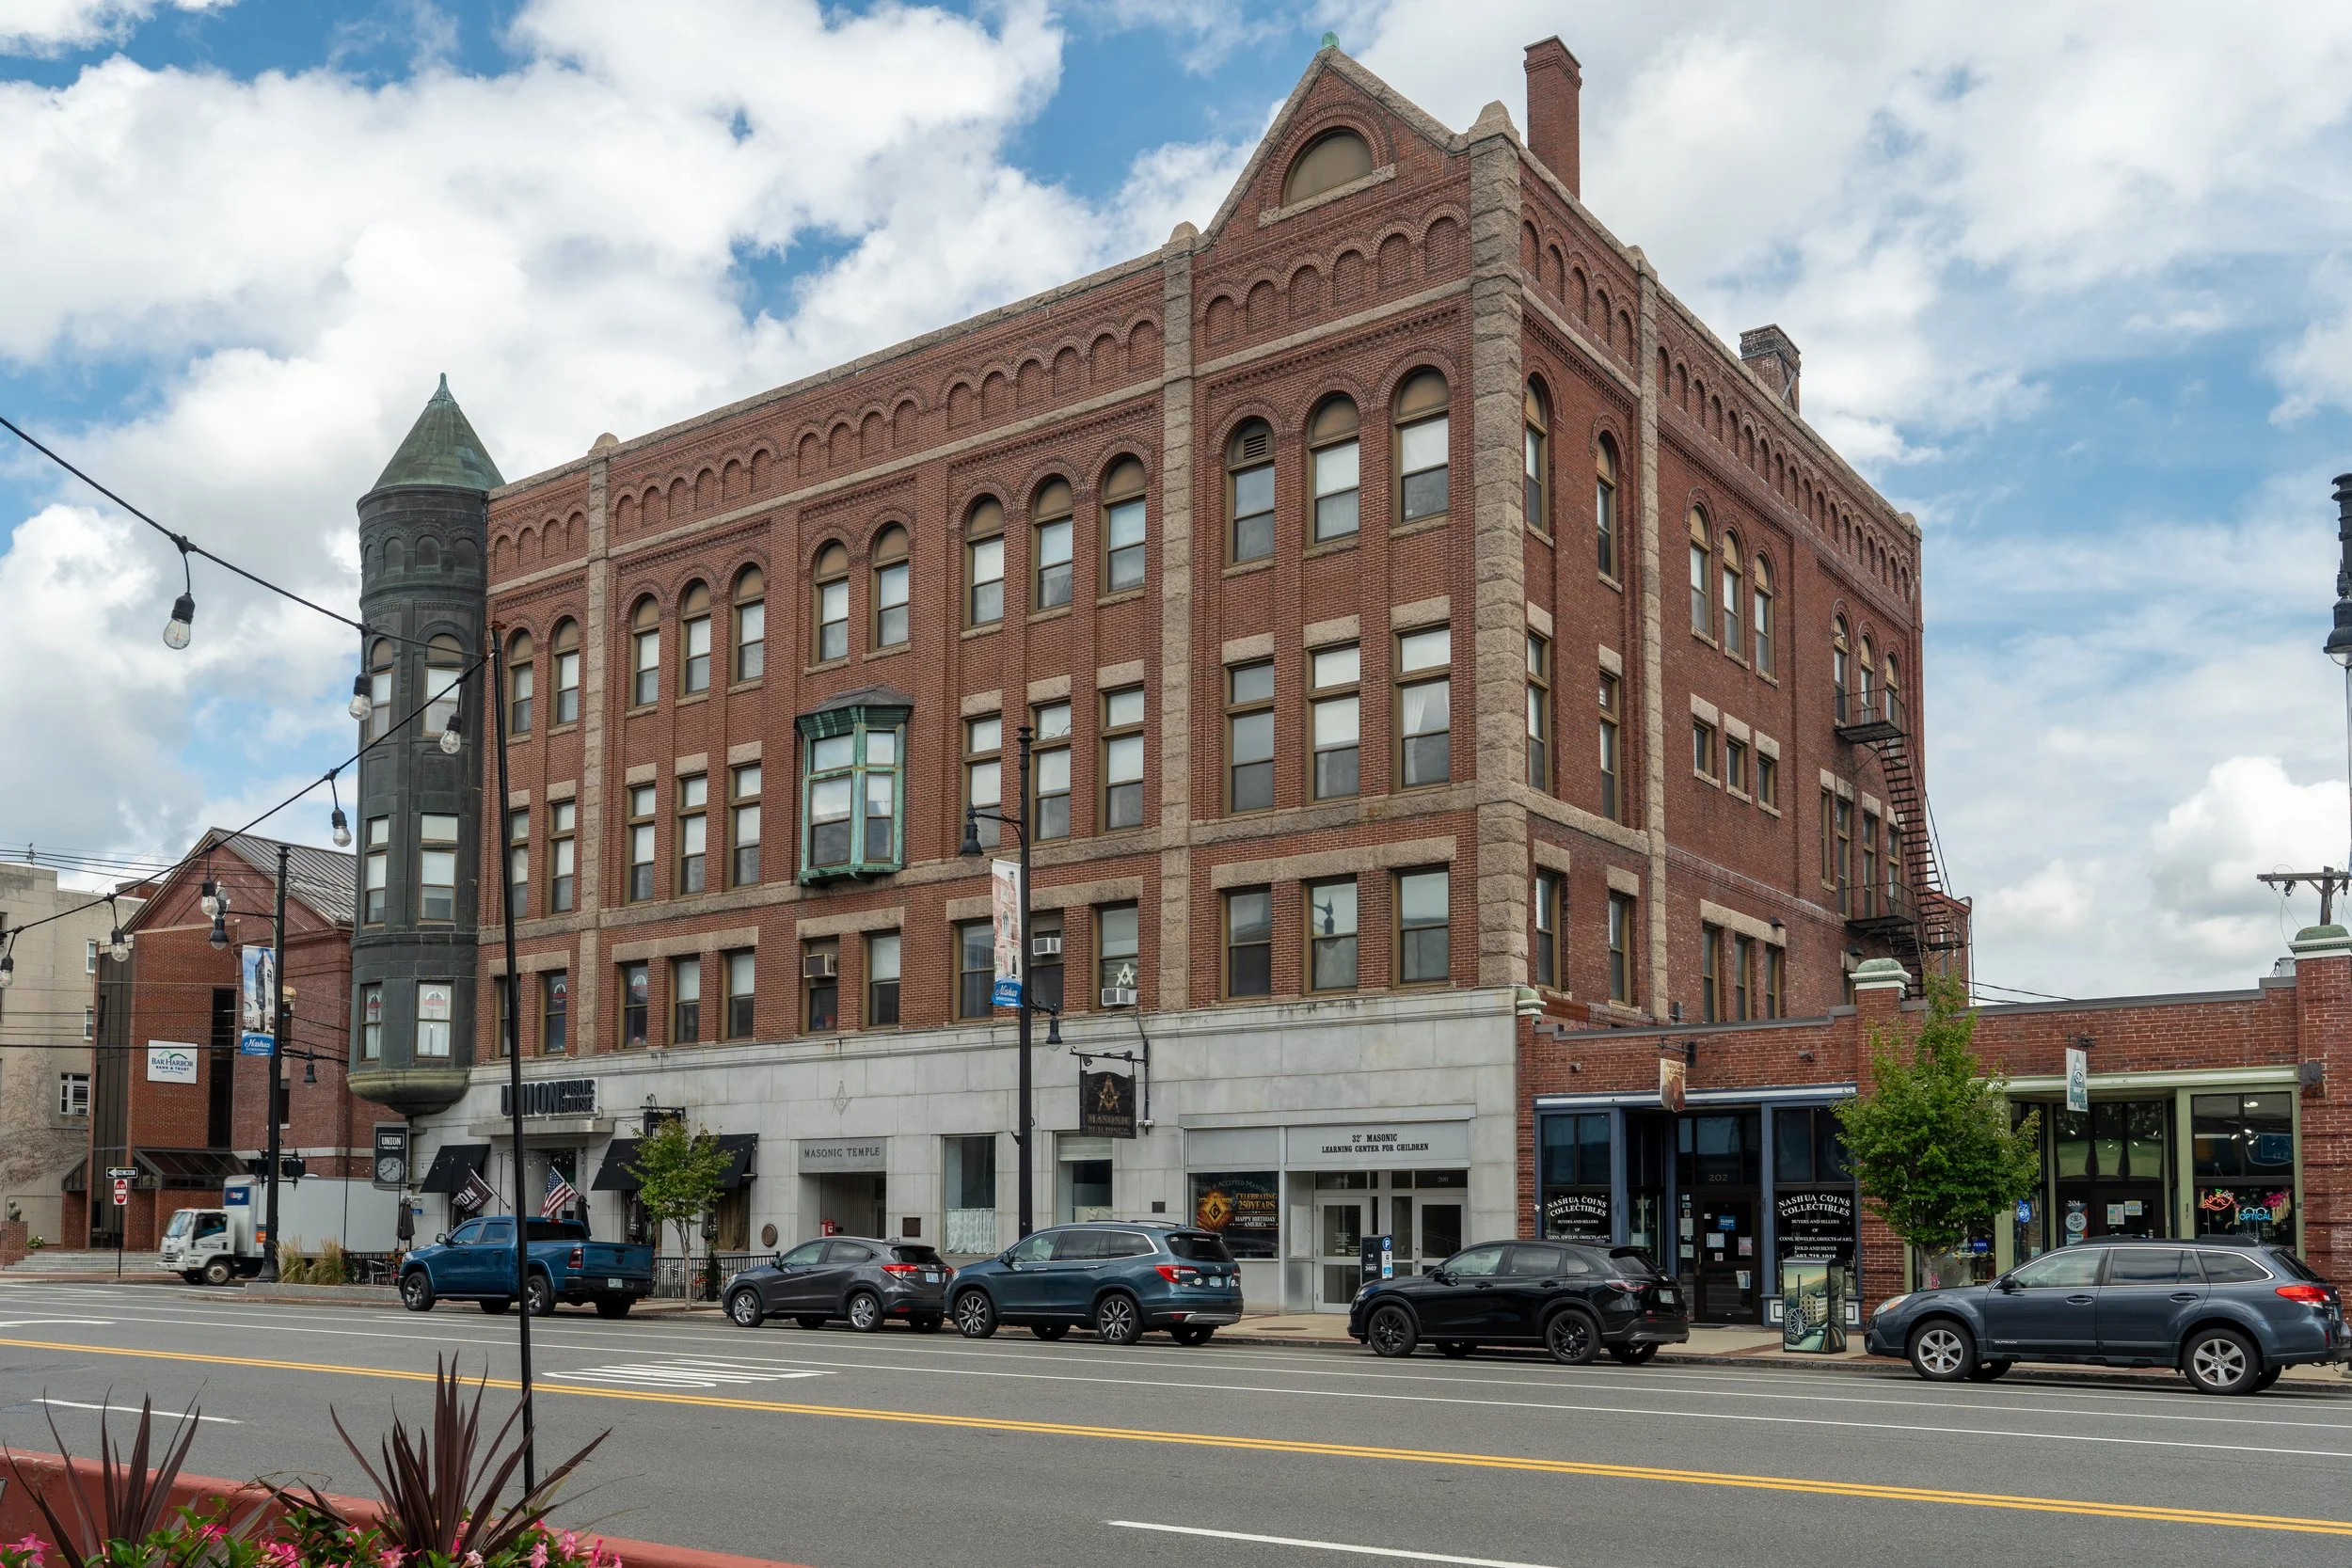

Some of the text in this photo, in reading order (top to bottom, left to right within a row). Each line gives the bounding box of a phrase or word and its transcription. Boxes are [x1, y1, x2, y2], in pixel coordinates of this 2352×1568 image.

[559, 1080, 595, 1095] PUBLIC
[559, 1096, 595, 1113] HOUSE
[382, 1136, 401, 1146] UNION
[1366, 1133, 1398, 1142] MASONIC
[1396, 1143, 1428, 1151] CHILDREN
[804, 1148, 881, 1158] MASONIC TEMPLE
[1547, 1196, 1607, 1210] NASHUA COINS
[1778, 1195, 1851, 1208] NASHUA COINS
[1550, 1205, 1606, 1216] COLLECTIBLES
[1782, 1204, 1850, 1216] COLLECTIBLES
[2239, 1212, 2273, 1221] OPTICAL
